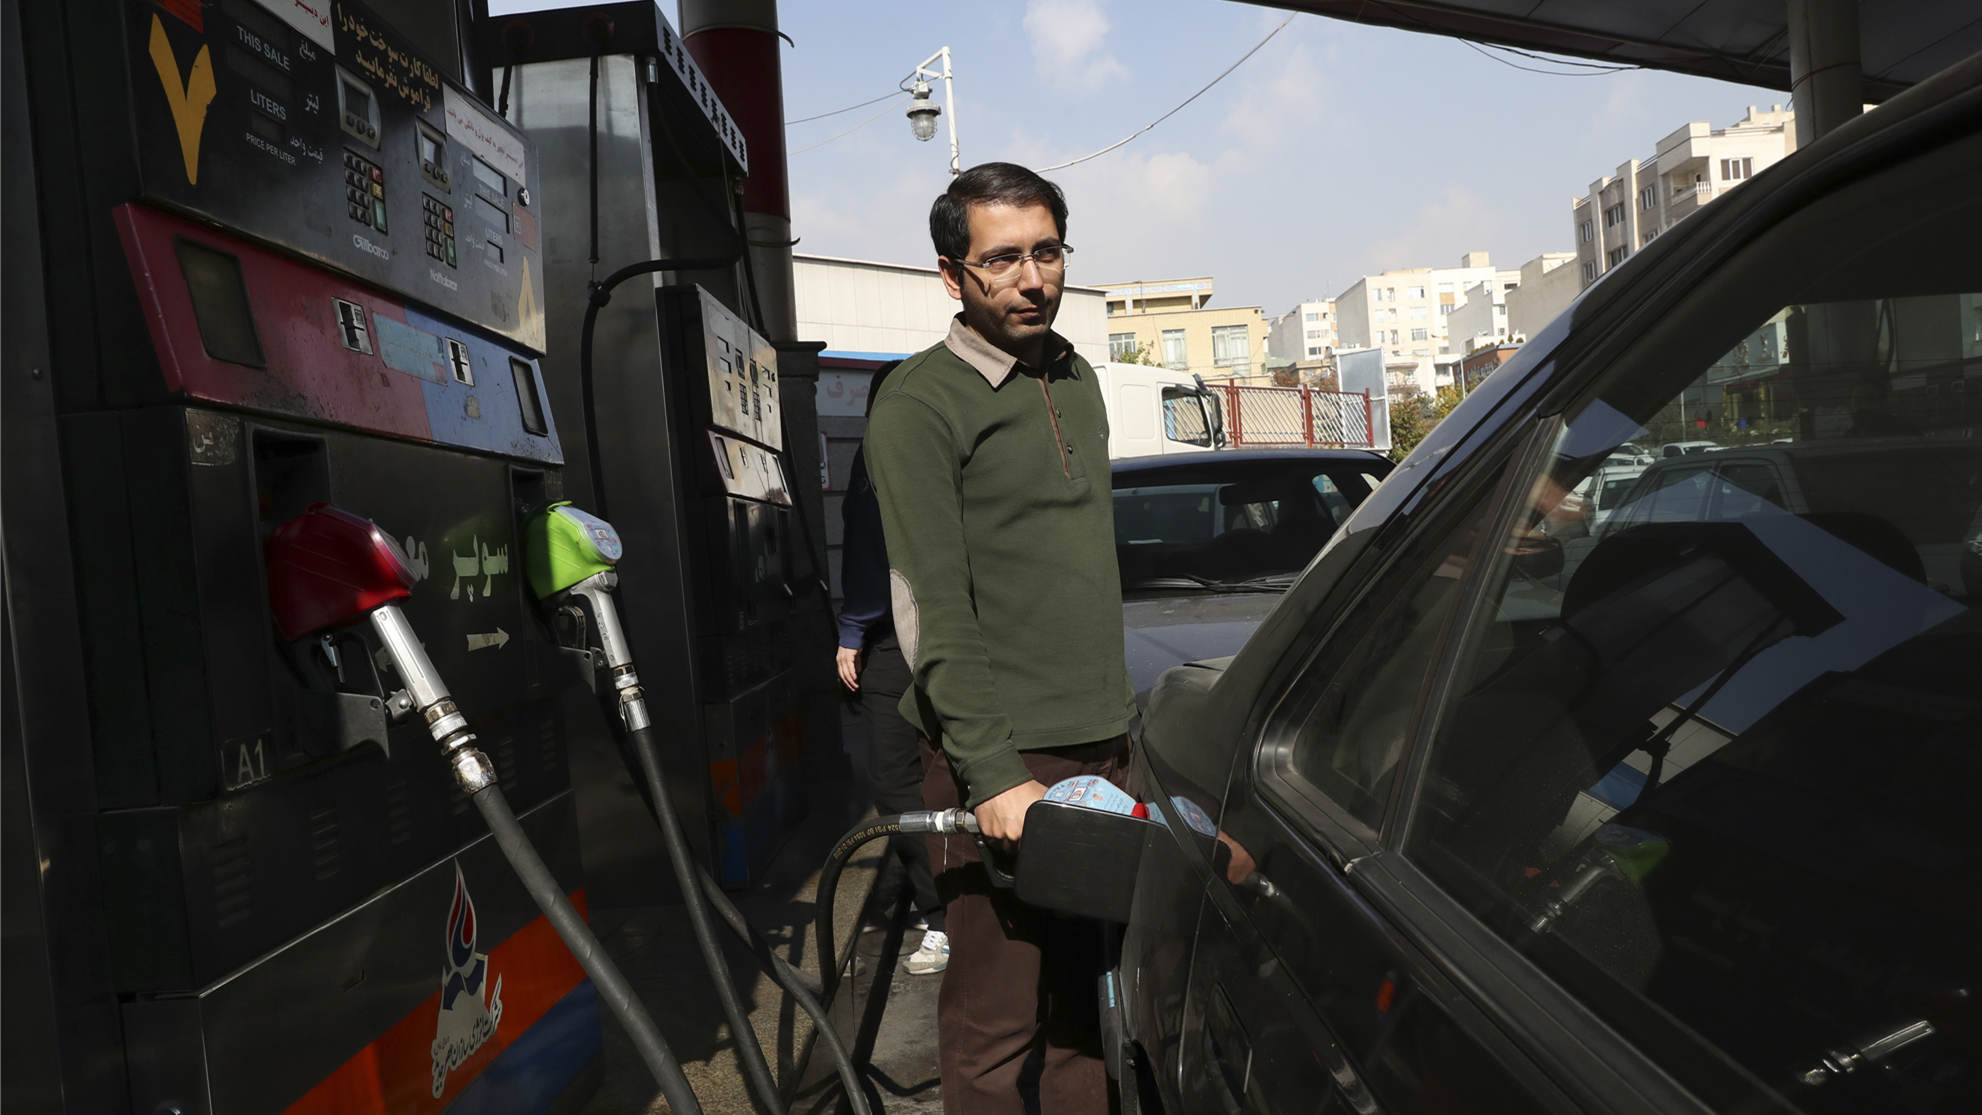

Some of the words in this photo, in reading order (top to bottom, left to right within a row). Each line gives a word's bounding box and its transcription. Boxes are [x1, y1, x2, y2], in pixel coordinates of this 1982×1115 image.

[236, 25, 262, 53] THIS
[263, 43, 291, 71] SALE
[249, 88, 287, 121] LITERS
[245, 132, 265, 151] PRICE
[265, 143, 280, 157] PER
[279, 149, 296, 165] LITER
[450, 534, 509, 602] سوپر
[237, 738, 265, 783] A1
